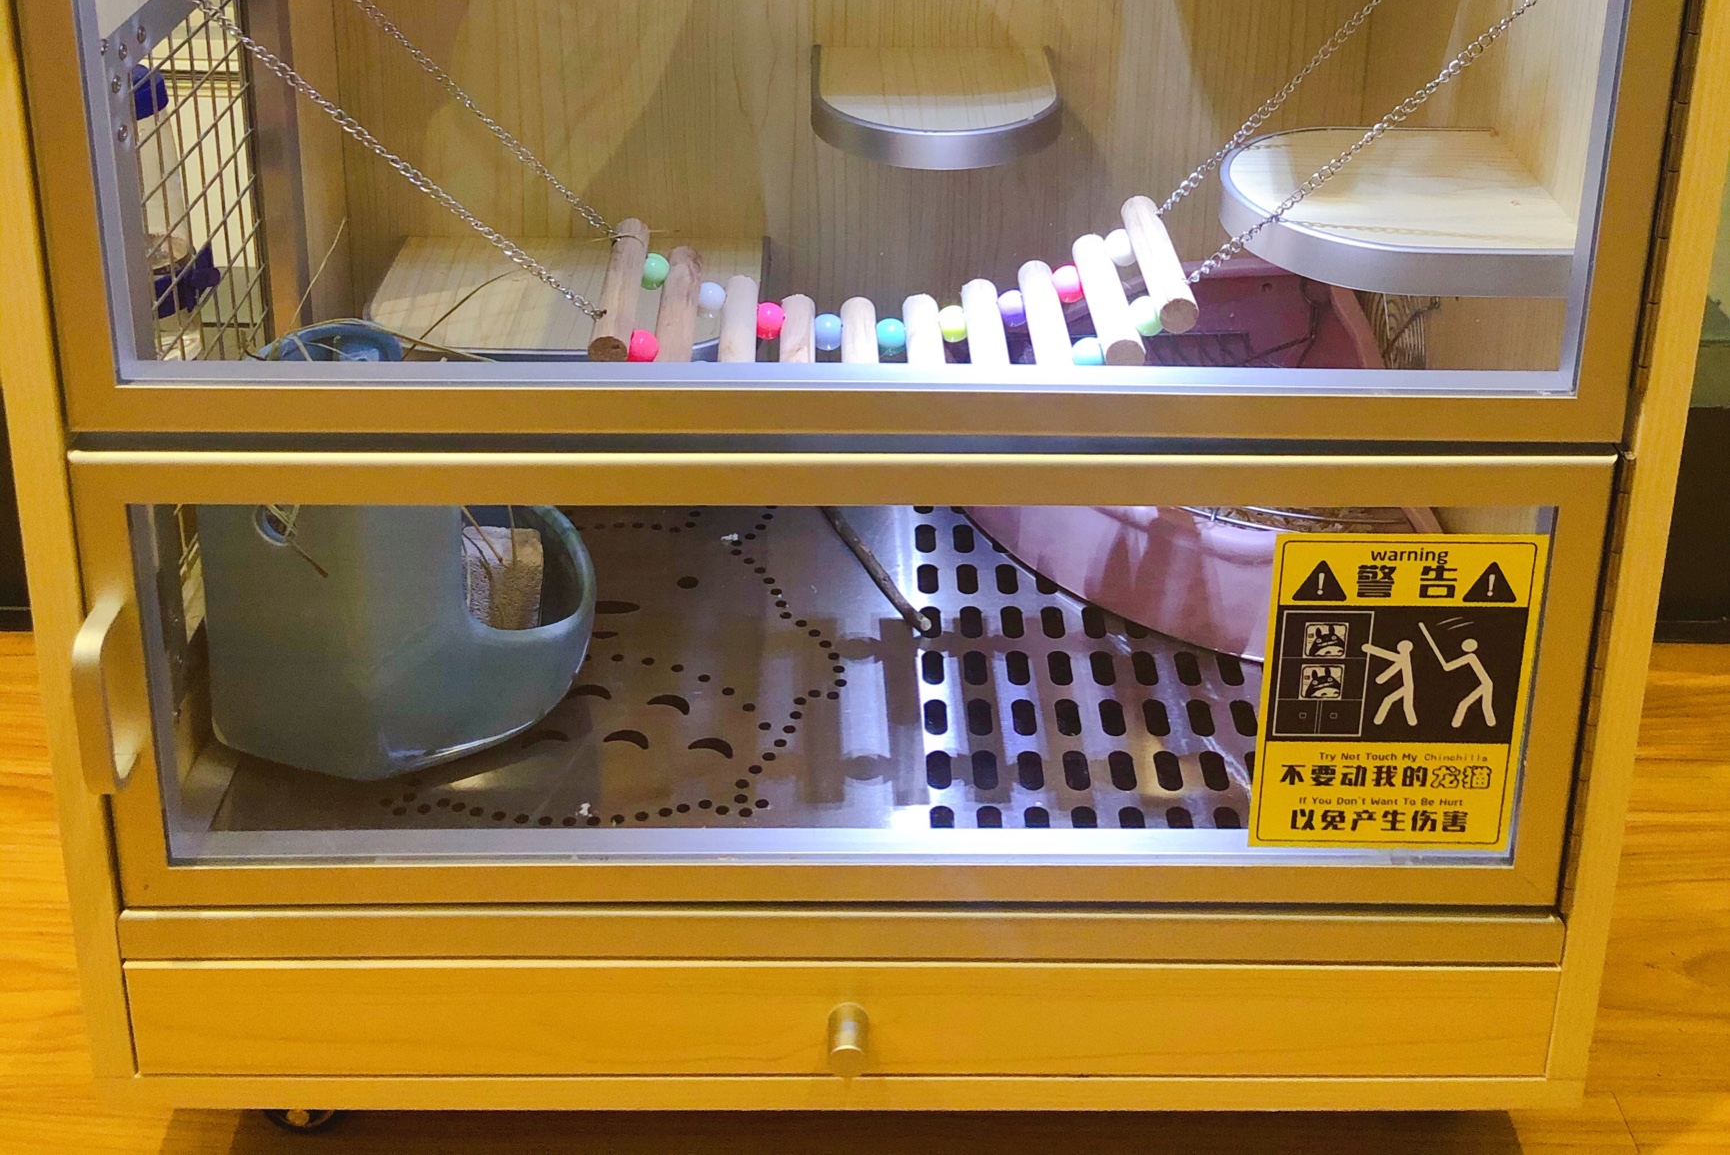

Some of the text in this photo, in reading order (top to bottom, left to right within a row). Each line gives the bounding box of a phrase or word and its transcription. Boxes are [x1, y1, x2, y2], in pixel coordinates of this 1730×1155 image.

[1371, 547, 1449, 565] warning
[1356, 564, 1458, 598] 警告
[1319, 752, 1488, 762] Try Not Touch My Chinchilla
[1280, 764, 1492, 790] 不要动我的龙猫
[1299, 797, 1307, 805] If
[1312, 797, 1332, 806] You
[1371, 798, 1398, 806] Want
[1404, 798, 1416, 806] To
[1421, 798, 1435, 806] Be
[1440, 798, 1463, 807] Hurt
[1290, 809, 1468, 833] 以免产生伤害
